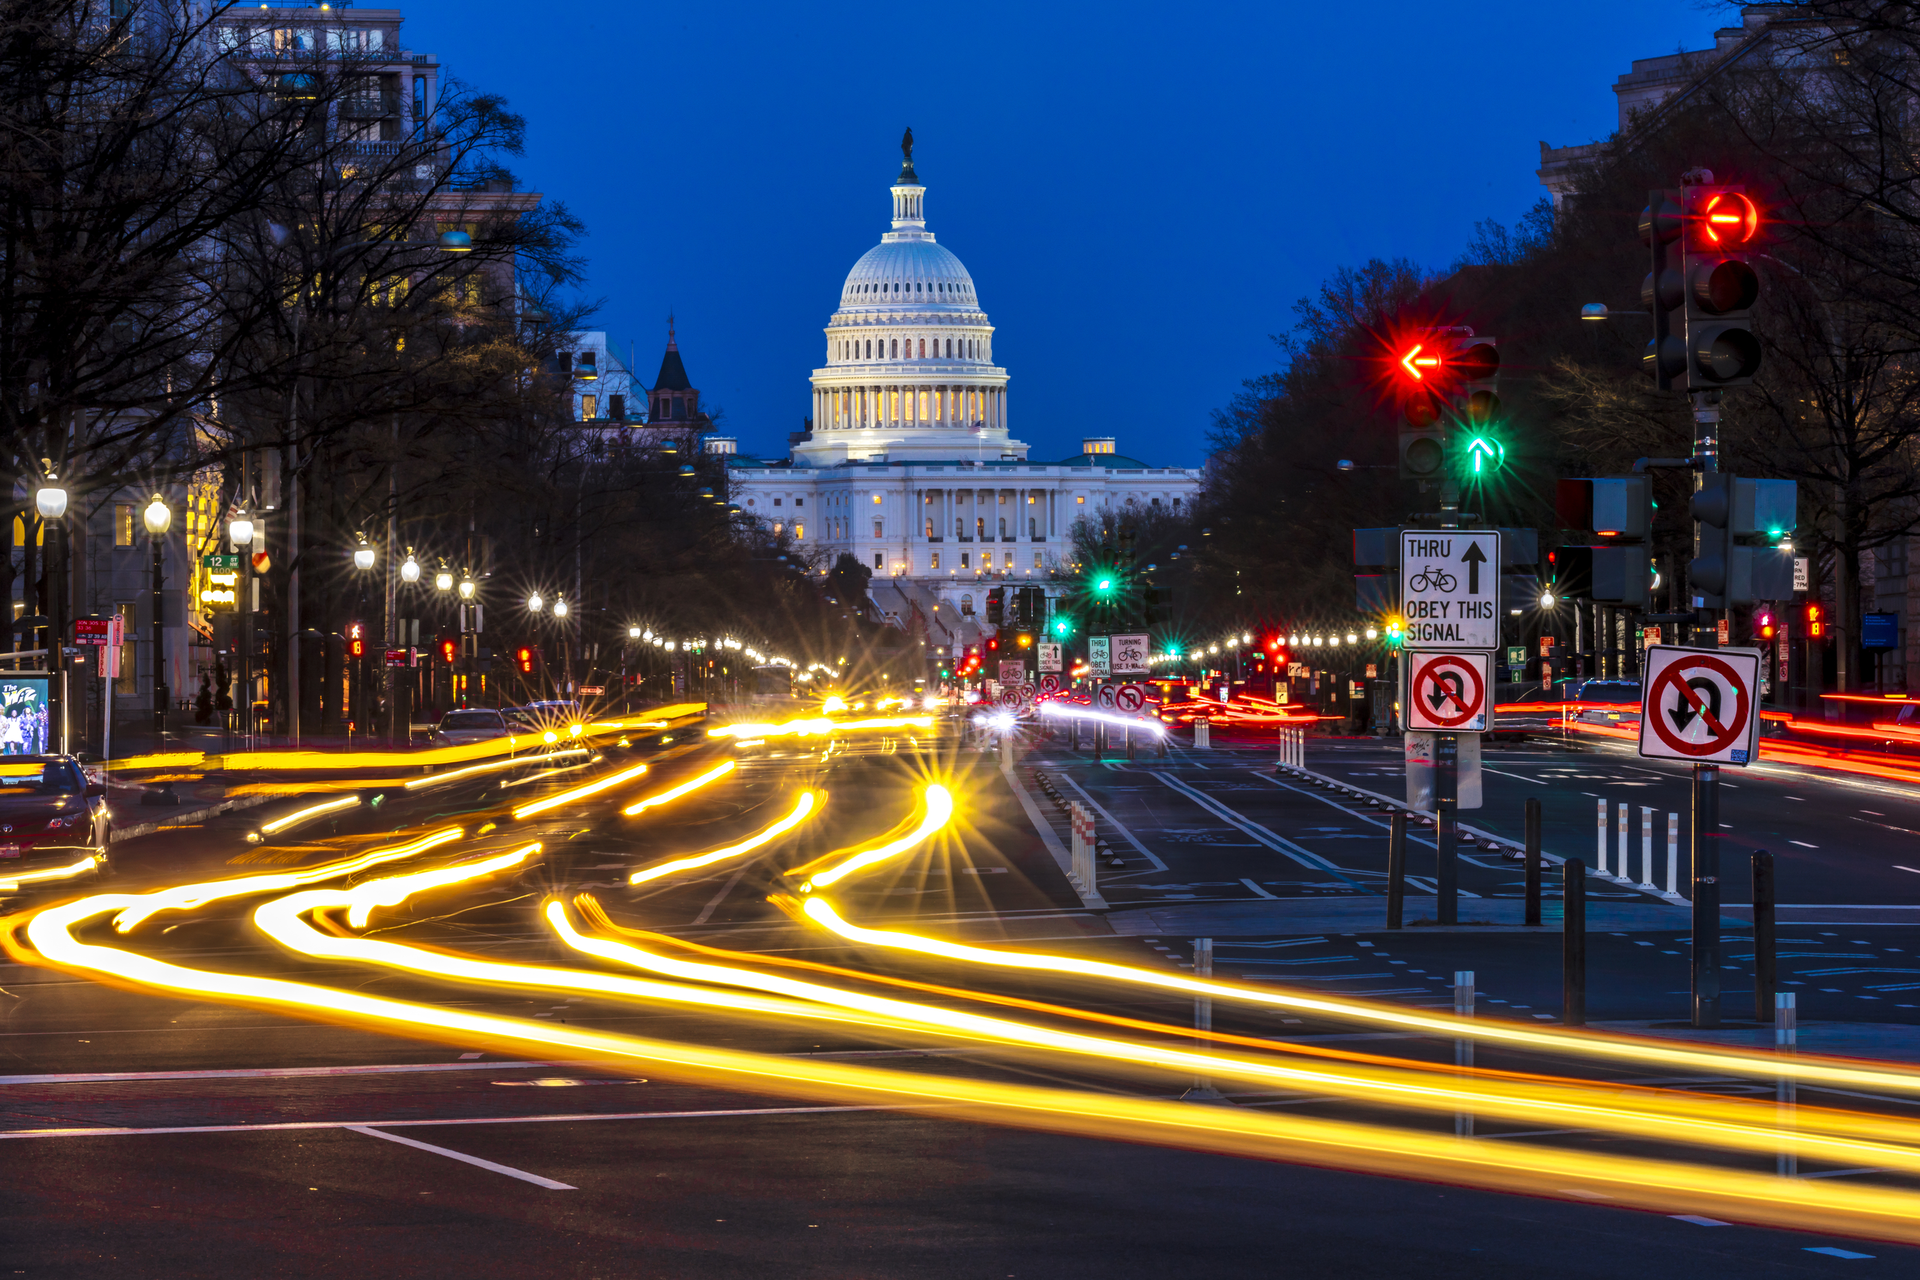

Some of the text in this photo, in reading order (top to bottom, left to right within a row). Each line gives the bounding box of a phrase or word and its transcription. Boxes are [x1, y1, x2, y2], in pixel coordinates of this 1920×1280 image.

[1408, 539, 1450, 557] THRU
[210, 557, 222, 567] 12
[1406, 600, 1493, 619] OBEY THIS
[1406, 623, 1465, 641] SIGNAL
[1091, 639, 1106, 647] THRU
[1118, 638, 1142, 646] TURNING
[1091, 660, 1106, 668] OBEY
[3, 684, 18, 692] The
